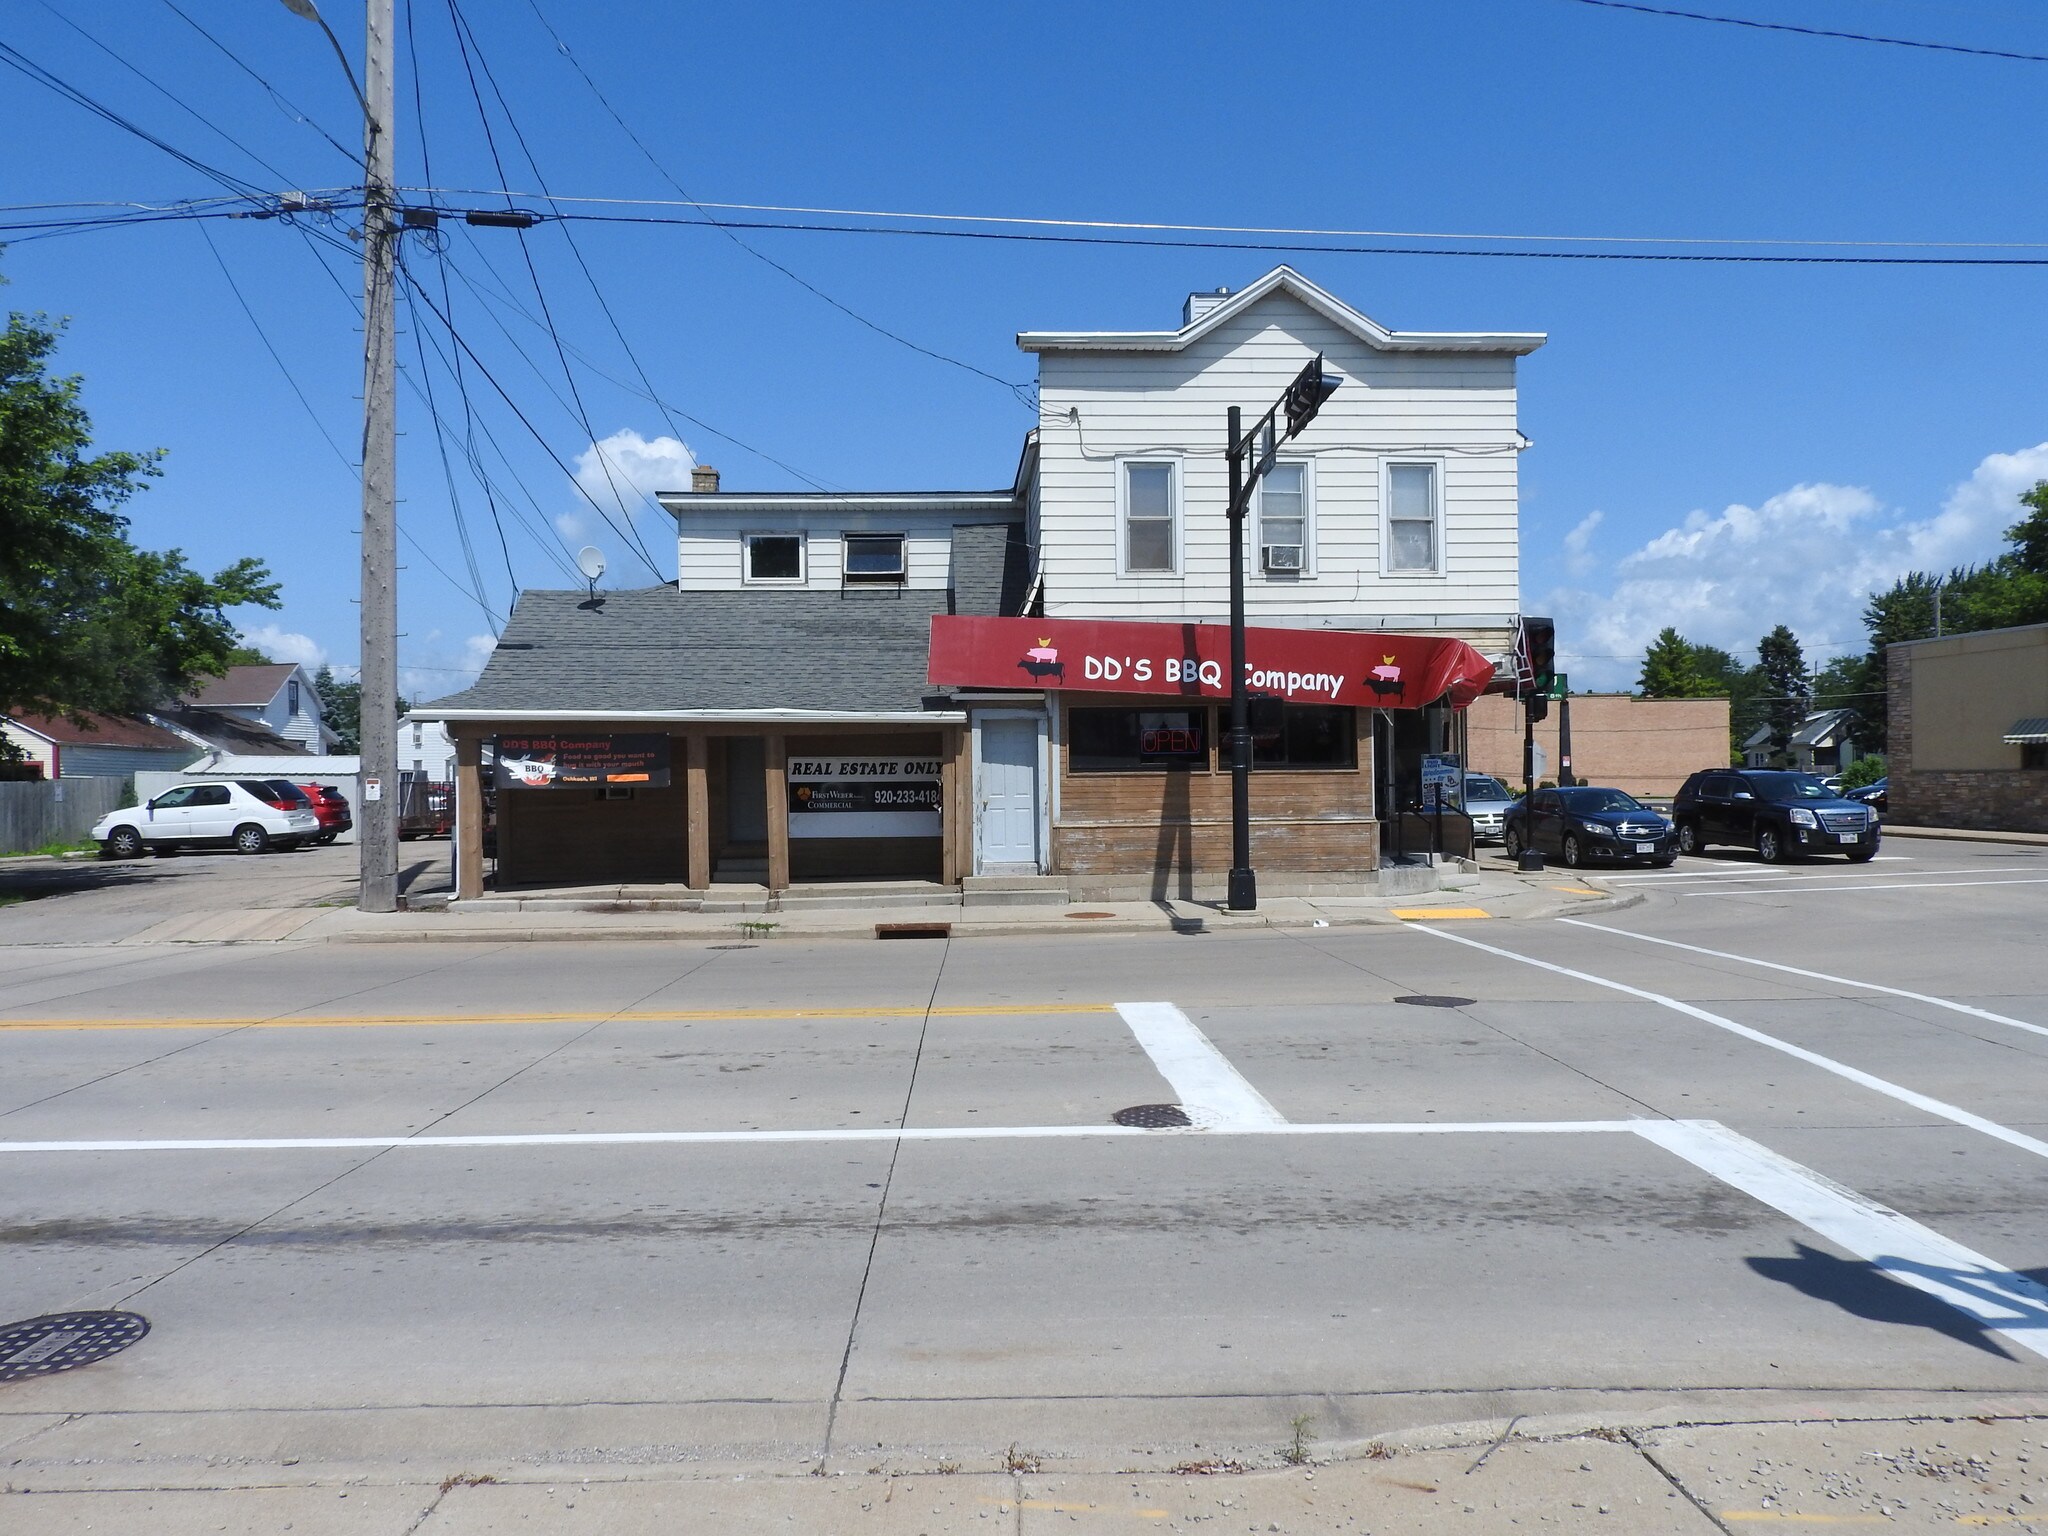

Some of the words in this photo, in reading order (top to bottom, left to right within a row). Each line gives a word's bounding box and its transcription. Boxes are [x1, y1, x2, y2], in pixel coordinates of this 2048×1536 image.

[1085, 655, 1152, 681] DD'S
[1165, 658, 1222, 689] BBQ
[532, 740, 557, 750] BBQ
[560, 740, 612, 751] Company
[1142, 730, 1198, 752] OPEN
[593, 753, 612, 761] good
[613, 753, 626, 761] you
[525, 765, 544, 773] BBQ
[602, 761, 620, 769] your
[621, 760, 645, 768] mouth
[792, 762, 833, 775] REAL
[839, 762, 898, 775] ESTATE
[904, 761, 943, 775] ONLY
[874, 790, 940, 803] 920-233-418
